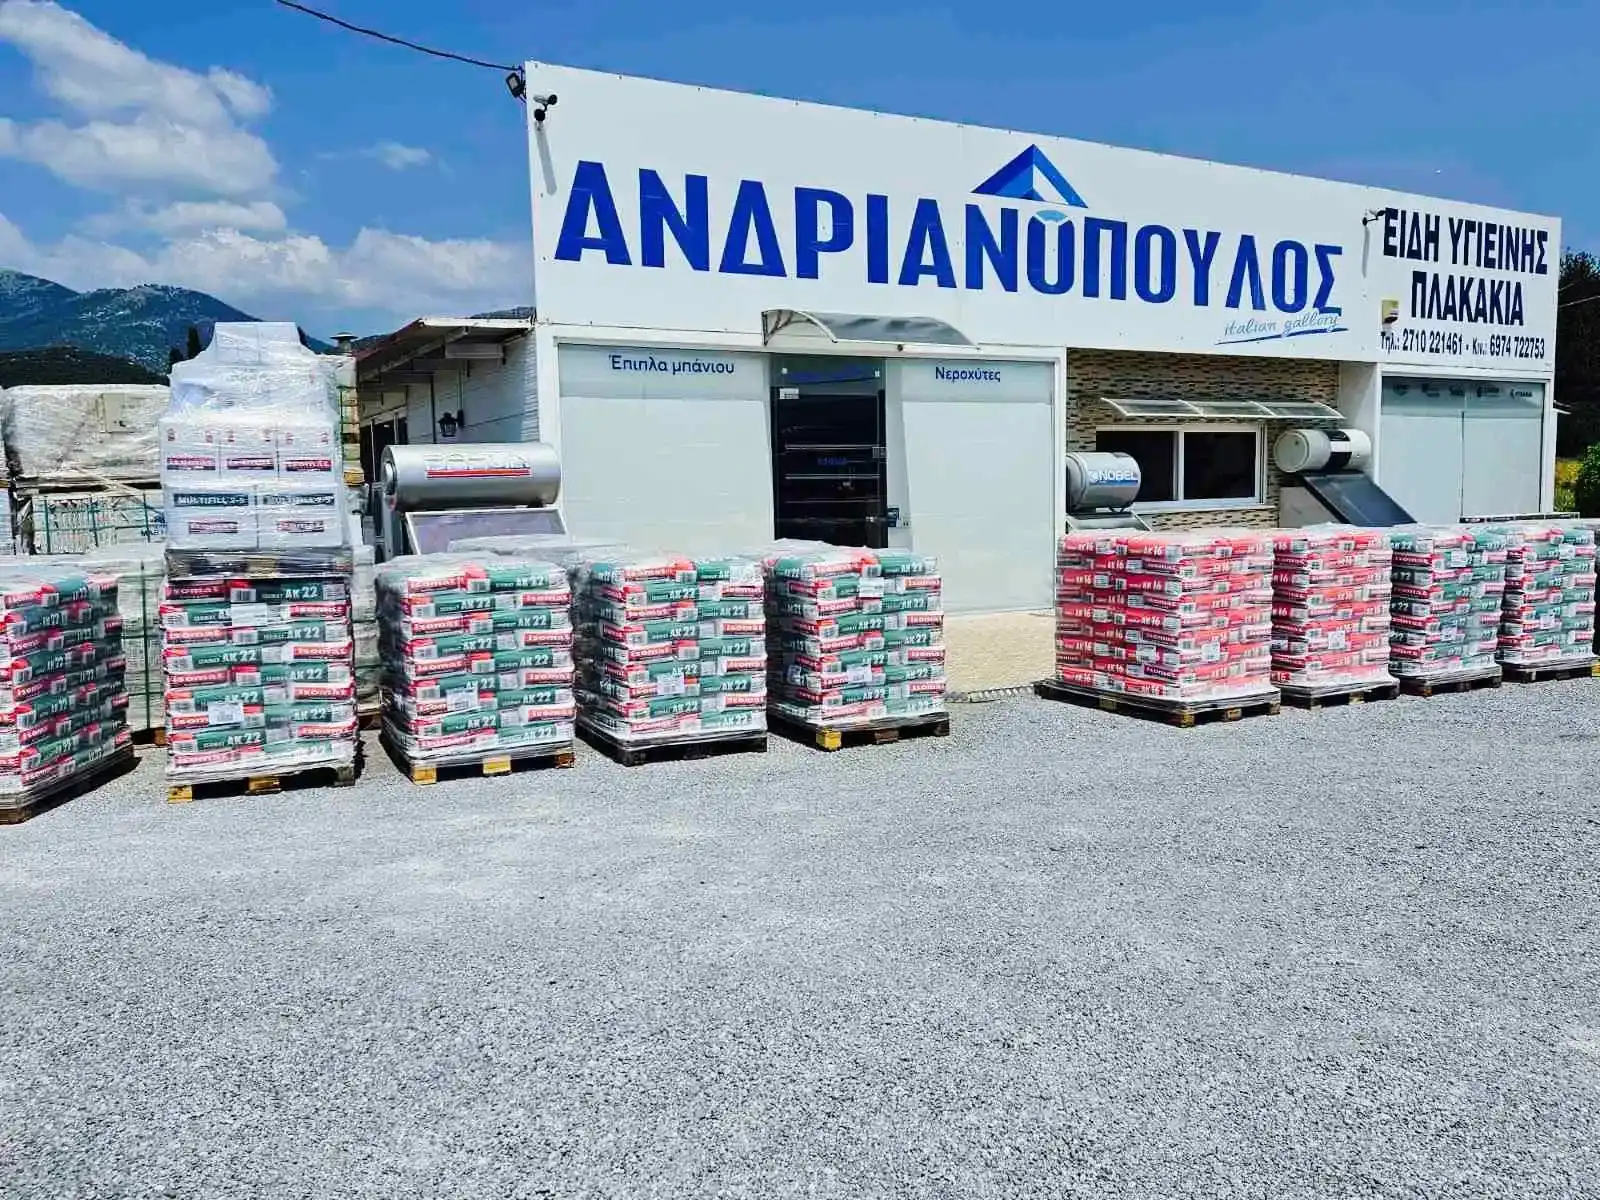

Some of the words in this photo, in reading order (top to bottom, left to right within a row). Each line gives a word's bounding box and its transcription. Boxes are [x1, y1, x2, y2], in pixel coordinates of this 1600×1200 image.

[554, 160, 1343, 316] ΑΝΔΡΙΑΝΟΠΟΥΛΟΣ
[1384, 207, 1440, 263] ΕΙΔΗ
[1449, 216, 1548, 275] ΥΓΙΕΙΝΗΣ
[1411, 270, 1524, 326] ΠΛΑΚΑΚΙΑ
[1225, 318, 1276, 336] italian
[1403, 328, 1426, 352] 2710
[1429, 331, 1462, 355] 221461
[1489, 334, 1511, 357] 6974
[1514, 336, 1544, 359] 722753
[609, 355, 667, 371] Έπιπλα
[672, 359, 734, 375] μπάνιου
[935, 366, 1000, 383] Νεροχύτες
[1100, 469, 1138, 481] NOBEL
[530, 576, 545, 586] 22
[285, 588, 300, 599] AK
[302, 586, 318, 598] 22
[476, 599, 491, 609] 22
[733, 606, 746, 616] 22
[532, 615, 547, 626] 22
[288, 629, 302, 639] AK
[303, 625, 320, 639] 22
[683, 626, 696, 637] 22
[734, 643, 747, 654] 22
[222, 652, 237, 662] AK
[239, 649, 257, 662] 22
[534, 654, 549, 665] 22
[290, 669, 304, 680] AK
[306, 667, 323, 679] 22
[735, 680, 748, 690] 22
[537, 692, 552, 703] 22
[482, 716, 497, 728] 22
